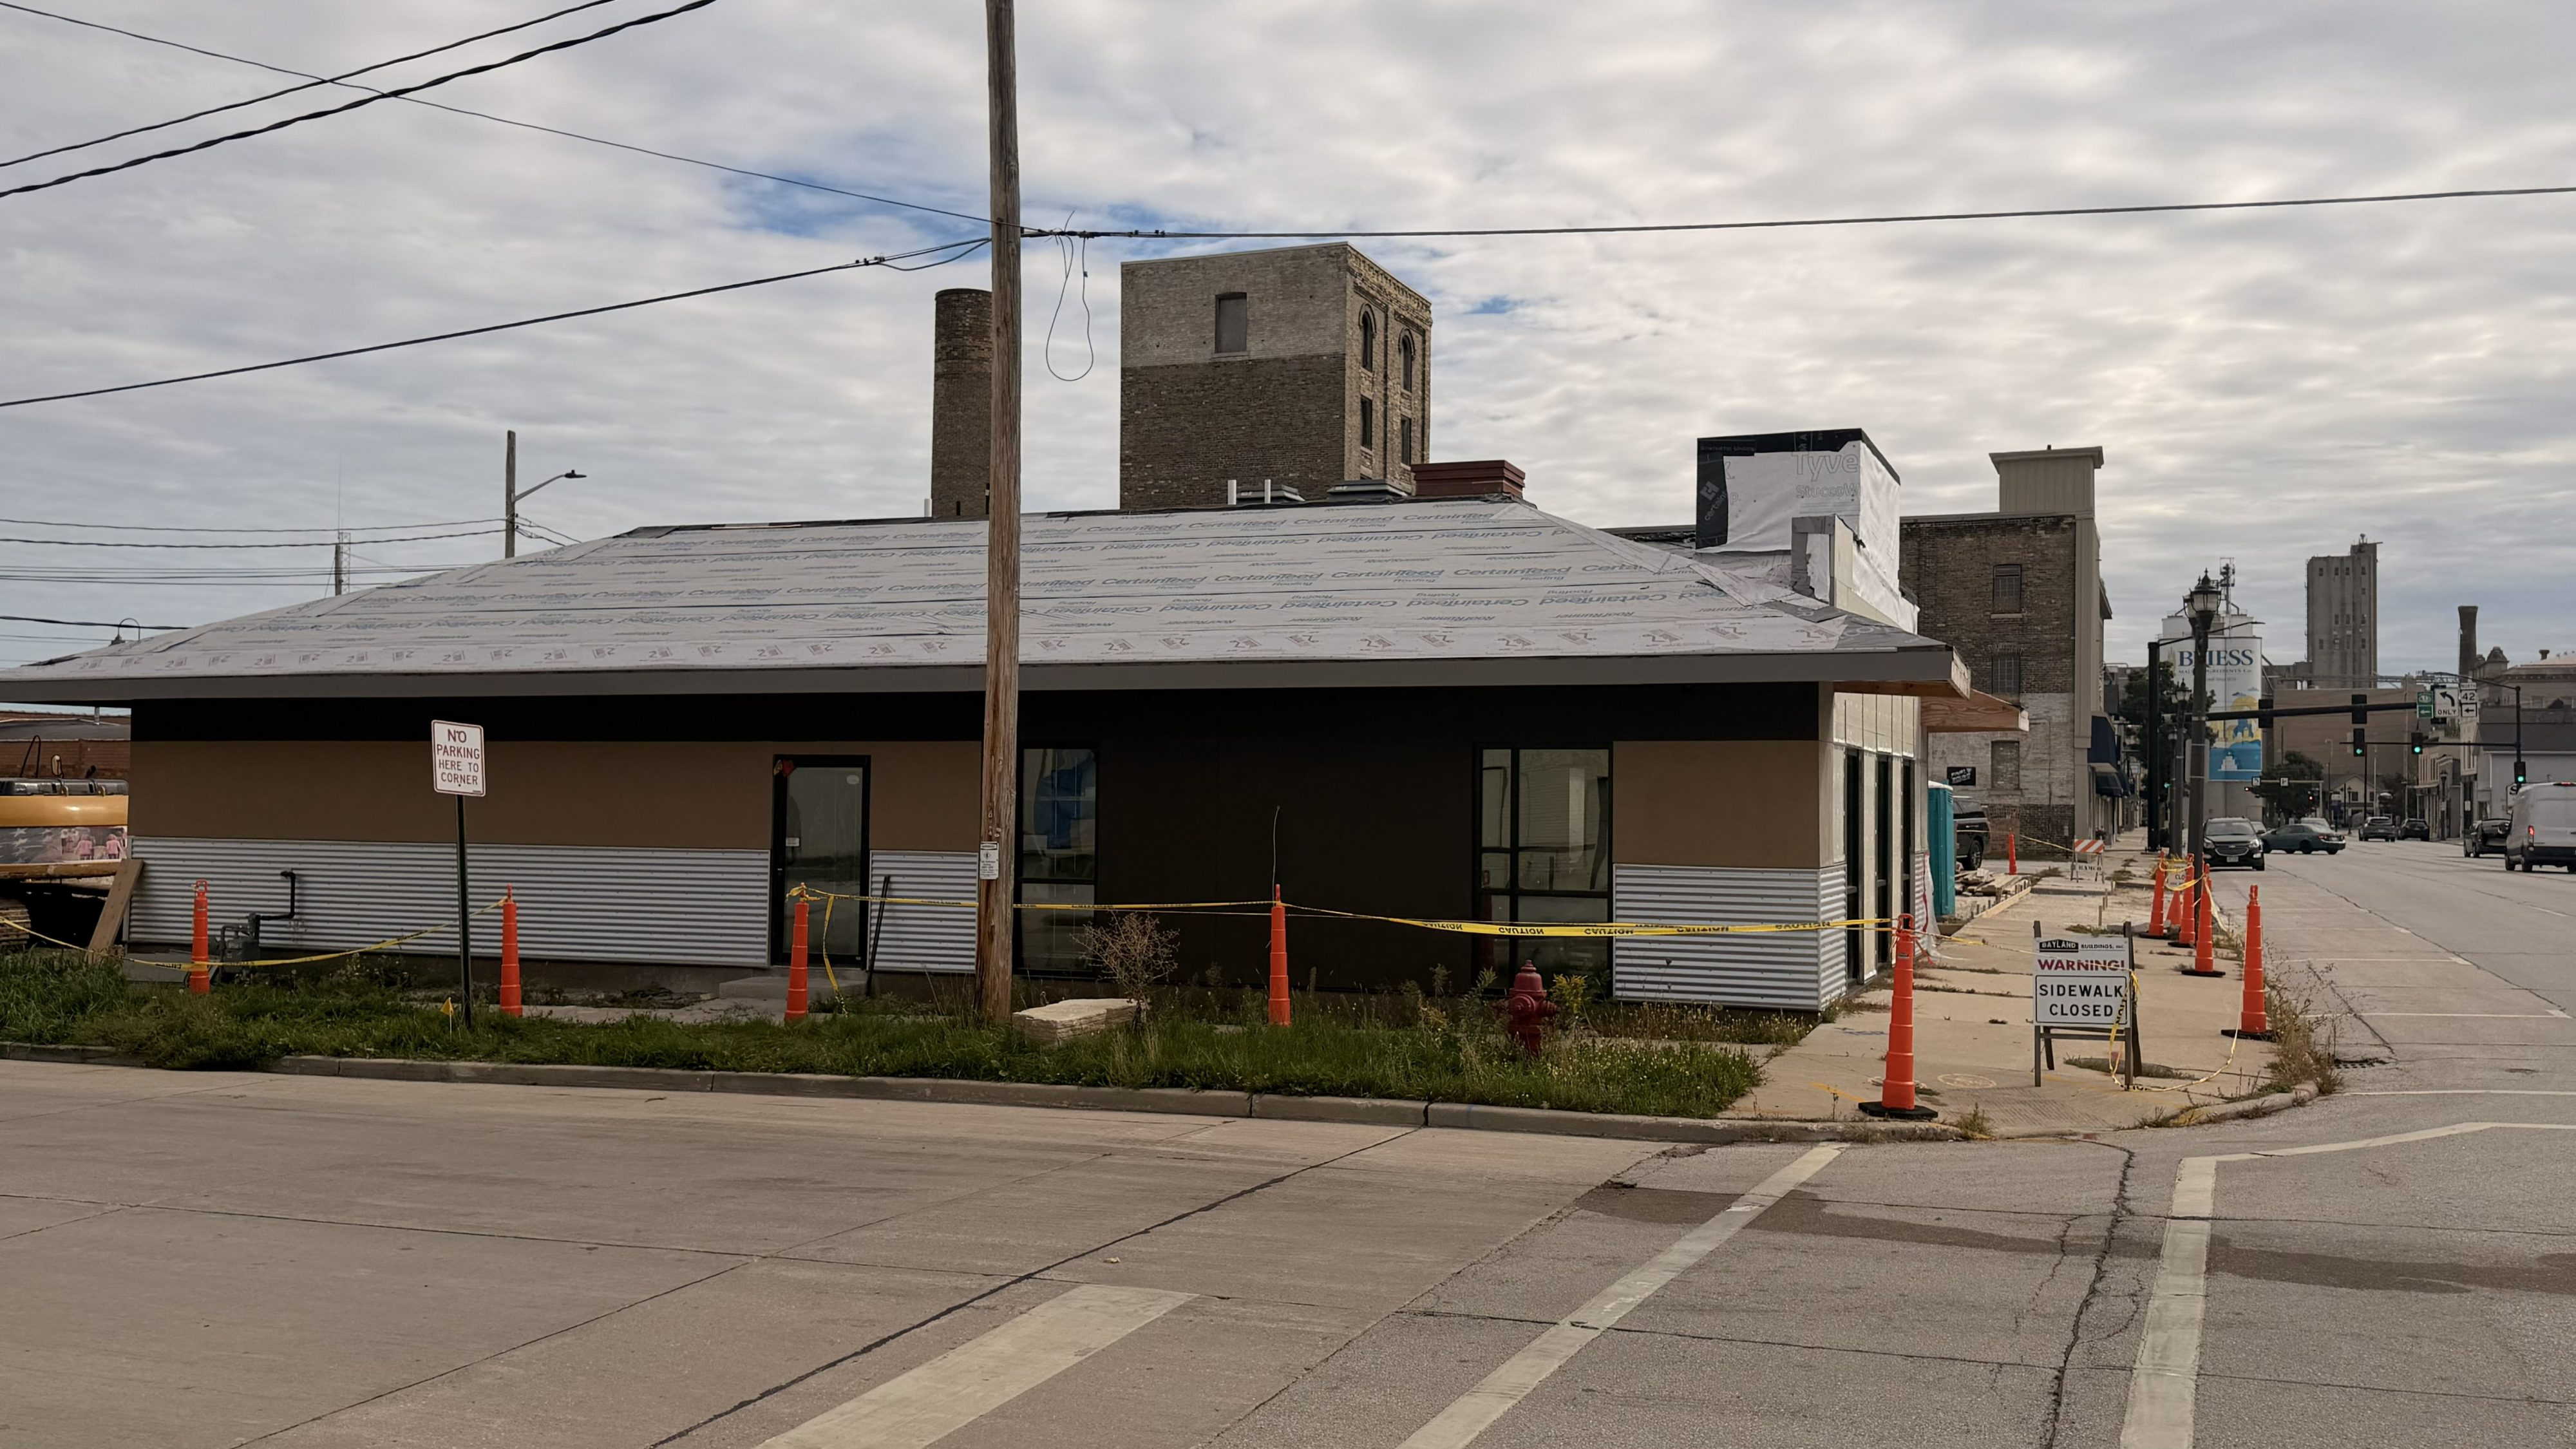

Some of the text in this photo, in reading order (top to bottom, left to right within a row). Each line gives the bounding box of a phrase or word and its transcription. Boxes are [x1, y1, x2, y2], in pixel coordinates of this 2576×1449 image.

[1792, 451, 1859, 482] Tyve
[1795, 484, 1861, 498] StuccoW
[1189, 520, 1286, 529] CertainTeed
[1294, 516, 1396, 525] CertainTeed
[1318, 534, 1423, 543] CertainTeed
[1431, 531, 1542, 540] CertainTeed
[1207, 538, 1310, 547] CertainTeed
[1215, 573, 1323, 582] CertainTeed
[1331, 569, 1444, 578] CertainTeed
[1454, 566, 1571, 576] CertainTeed
[1280, 599, 1397, 609] CertainTeed
[1406, 596, 1530, 607] CertainTeed
[1539, 593, 1667, 606] CertainTeed
[2178, 649, 2253, 667] BIESS
[2462, 692, 2476, 701] 42
[448, 728, 467, 743] NO
[437, 744, 480, 759] PARKING
[439, 759, 479, 773] HERE TO
[441, 772, 478, 785] CORNER
[2041, 940, 2076, 949] BAYLAND
[2038, 959, 2125, 971] WARNING!
[2039, 984, 2123, 998] SIDEWALK
[2049, 1003, 2113, 1017] CLOSED
